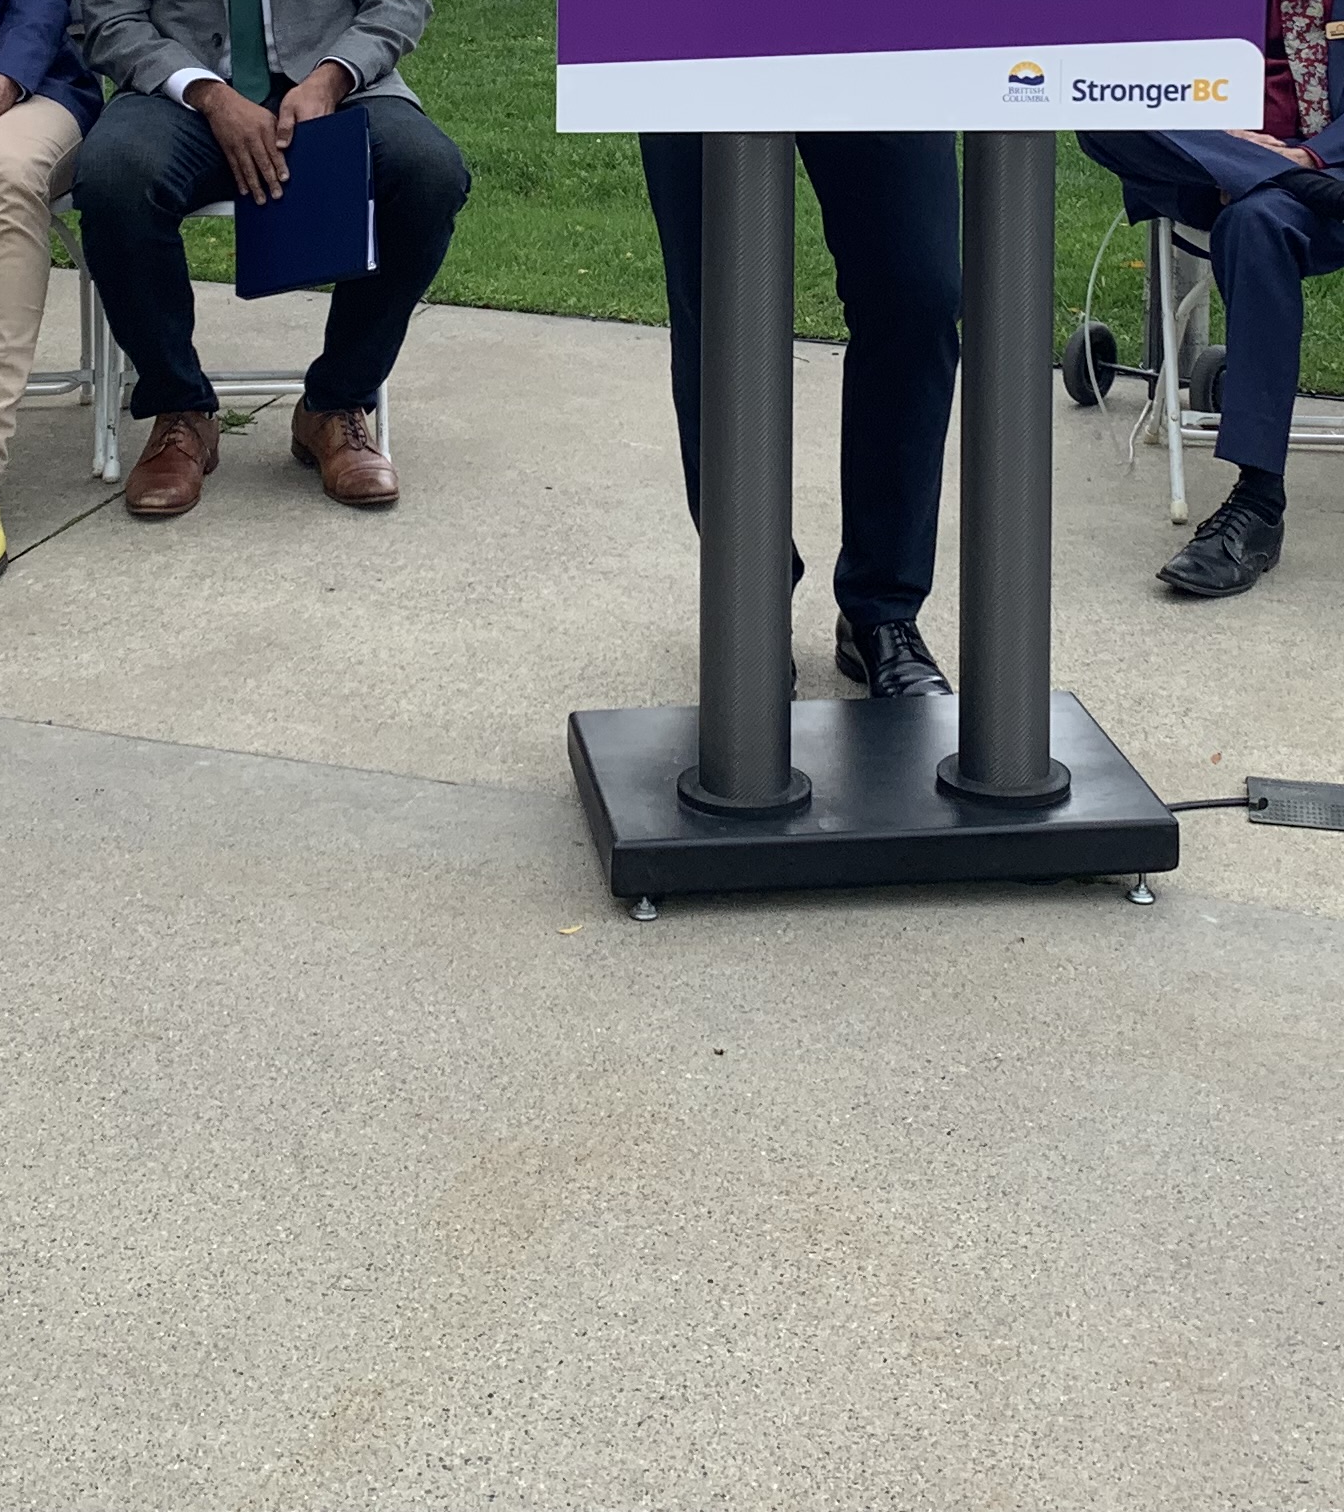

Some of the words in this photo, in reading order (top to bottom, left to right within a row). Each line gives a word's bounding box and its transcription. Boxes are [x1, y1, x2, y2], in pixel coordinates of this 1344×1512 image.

[1007, 86, 1045, 95] BRITISH
[1071, 78, 1230, 109] StrongerBC
[1002, 94, 1050, 104] COLUMBIA
